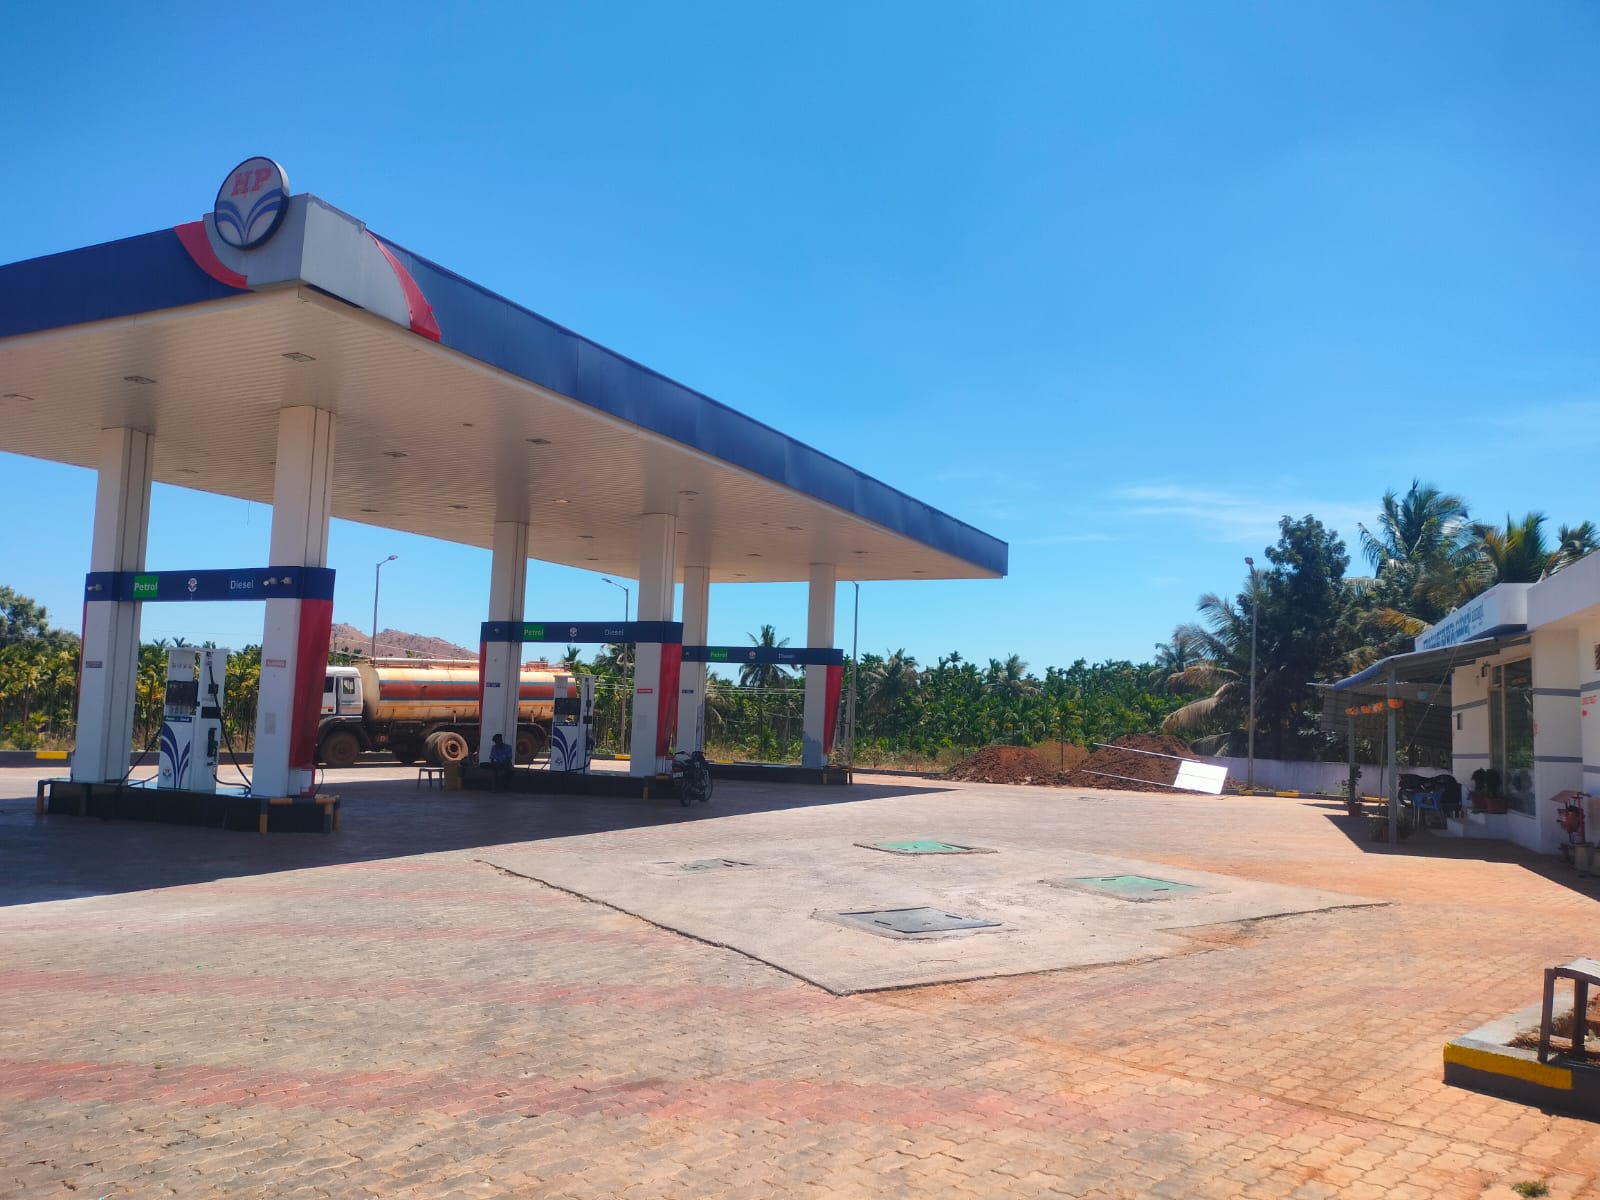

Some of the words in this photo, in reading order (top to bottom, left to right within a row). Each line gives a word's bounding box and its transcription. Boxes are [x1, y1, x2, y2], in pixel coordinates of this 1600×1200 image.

[231, 167, 272, 197] HP
[134, 582, 158, 591] Petrol
[230, 579, 254, 590] Diesel
[524, 628, 544, 636] Petrol
